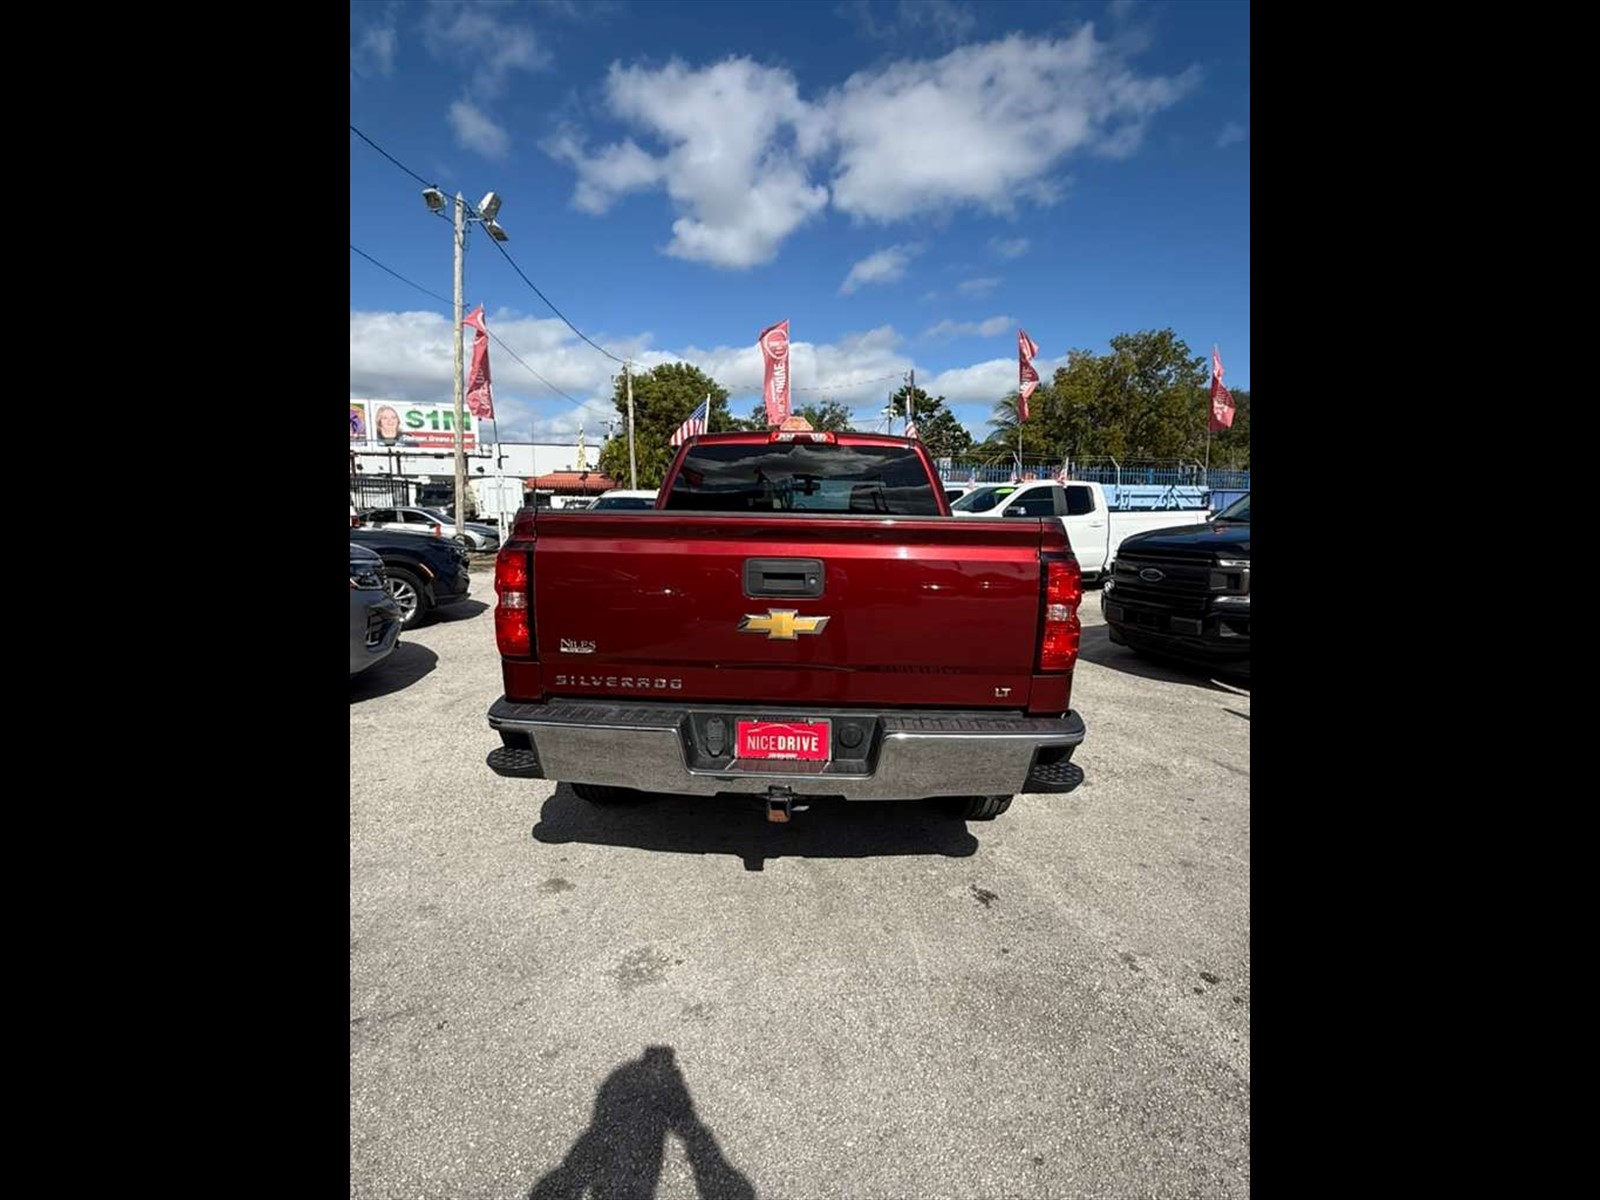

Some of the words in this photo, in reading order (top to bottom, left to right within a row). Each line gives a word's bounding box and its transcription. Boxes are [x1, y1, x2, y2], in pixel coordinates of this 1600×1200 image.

[555, 675, 682, 689] SILVERADO
[994, 687, 1012, 697] LT
[747, 735, 819, 751] NICEDRIVE
